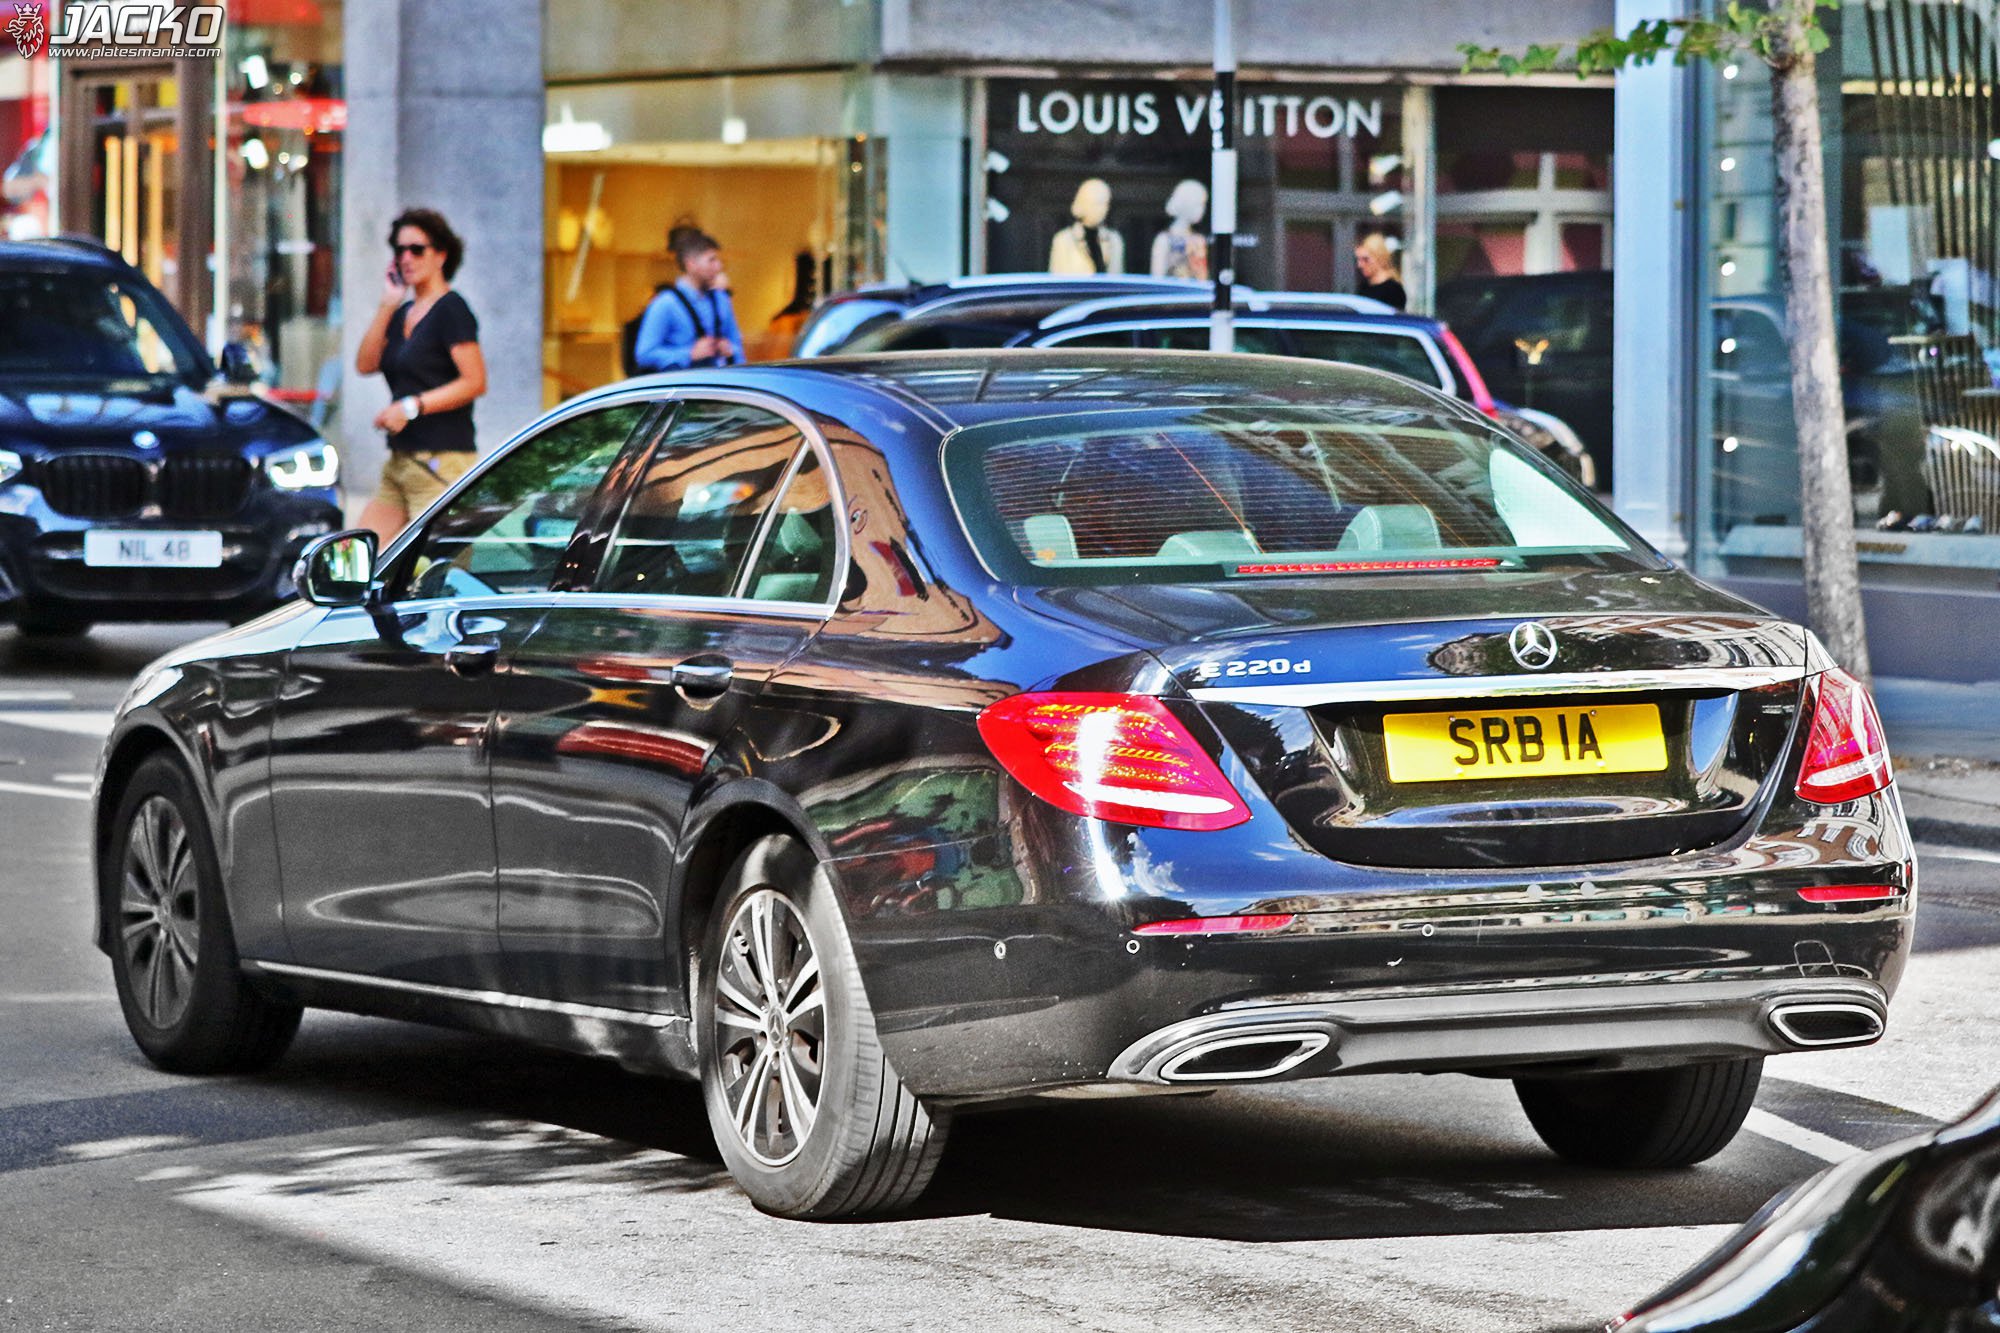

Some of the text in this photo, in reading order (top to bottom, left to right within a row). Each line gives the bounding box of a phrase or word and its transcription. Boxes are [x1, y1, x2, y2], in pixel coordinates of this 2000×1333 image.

[1017, 91, 1160, 136] LOUIS
[1174, 94, 1383, 138] VITTON
[118, 538, 191, 562] NIL 48
[1199, 658, 1312, 679] E 220d
[1449, 715, 1545, 766] SRB
